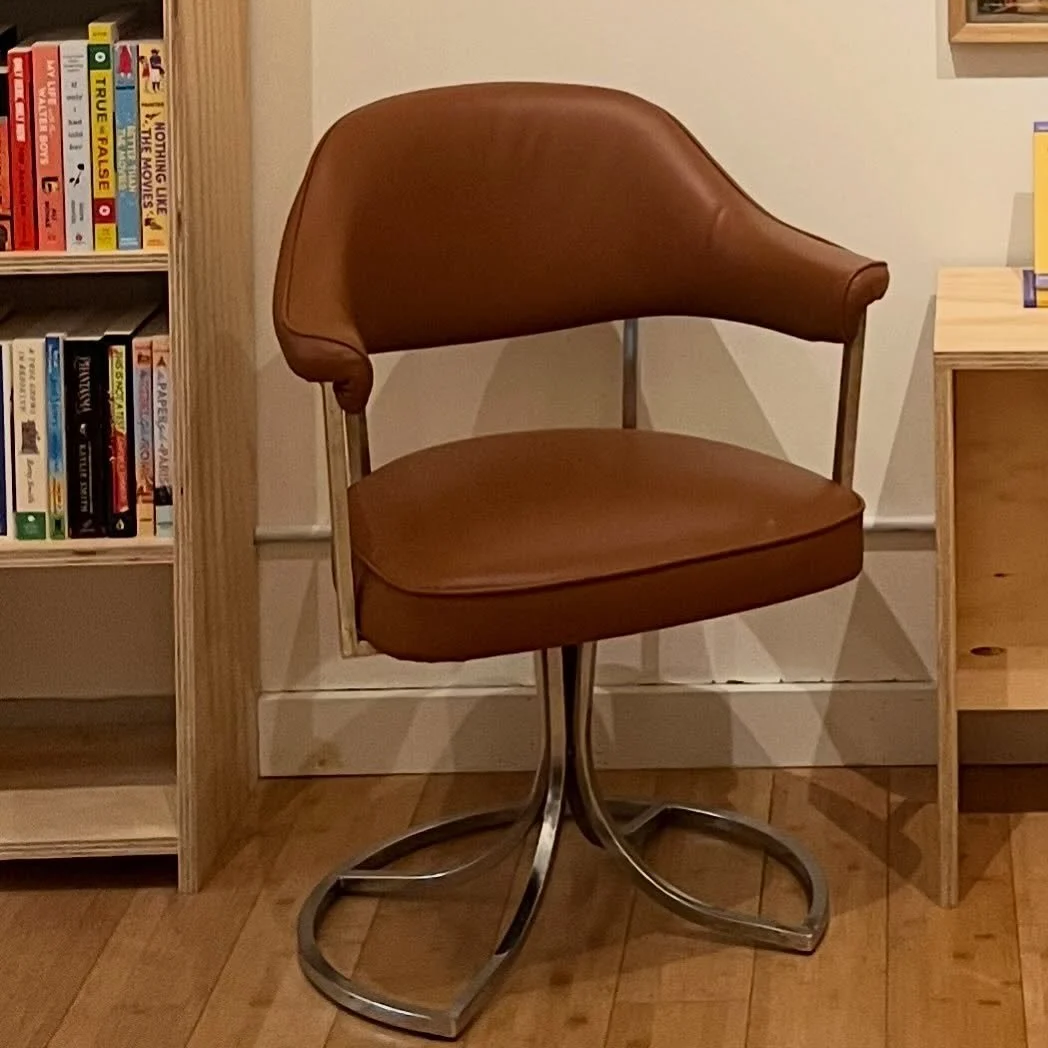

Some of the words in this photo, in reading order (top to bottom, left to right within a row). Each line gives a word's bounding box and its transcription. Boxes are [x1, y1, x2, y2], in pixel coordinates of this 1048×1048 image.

[38, 87, 47, 132] WALTER
[47, 80, 56, 105] LIFE
[96, 77, 107, 122] TRUE
[39, 135, 48, 165] BOYS
[97, 136, 110, 190] FALSE
[141, 128, 153, 154] THE
[154, 122, 167, 184] NOTHING
[142, 157, 154, 209] MOVIES
[156, 187, 167, 215] LIKE
